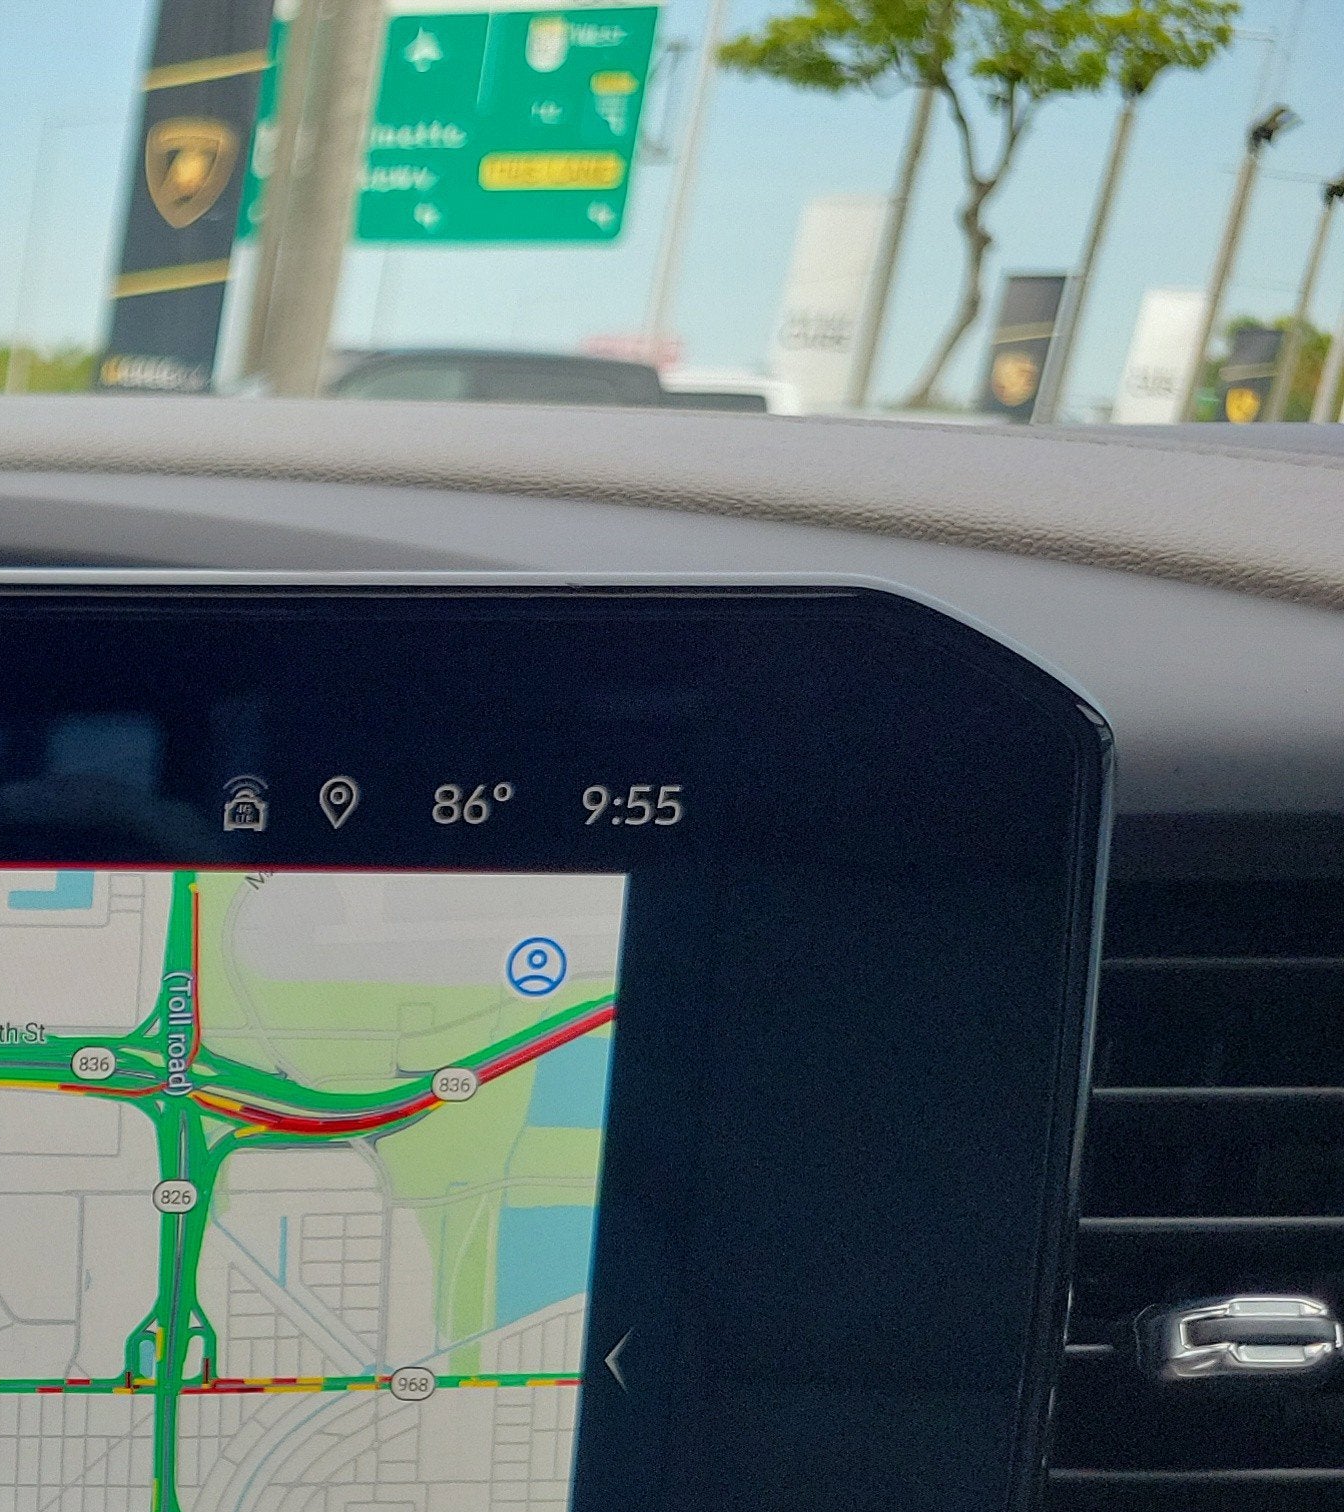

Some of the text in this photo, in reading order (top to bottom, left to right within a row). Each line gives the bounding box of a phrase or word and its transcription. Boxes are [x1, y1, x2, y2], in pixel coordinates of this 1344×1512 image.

[431, 782, 513, 825] 86°
[582, 784, 683, 826] 9:55
[24, 1023, 46, 1043] St
[162, 971, 194, 1096] (Toll road)
[79, 1055, 110, 1073] 836
[439, 1077, 470, 1094] 836
[161, 1189, 192, 1206] 826
[398, 1375, 428, 1393] 968
